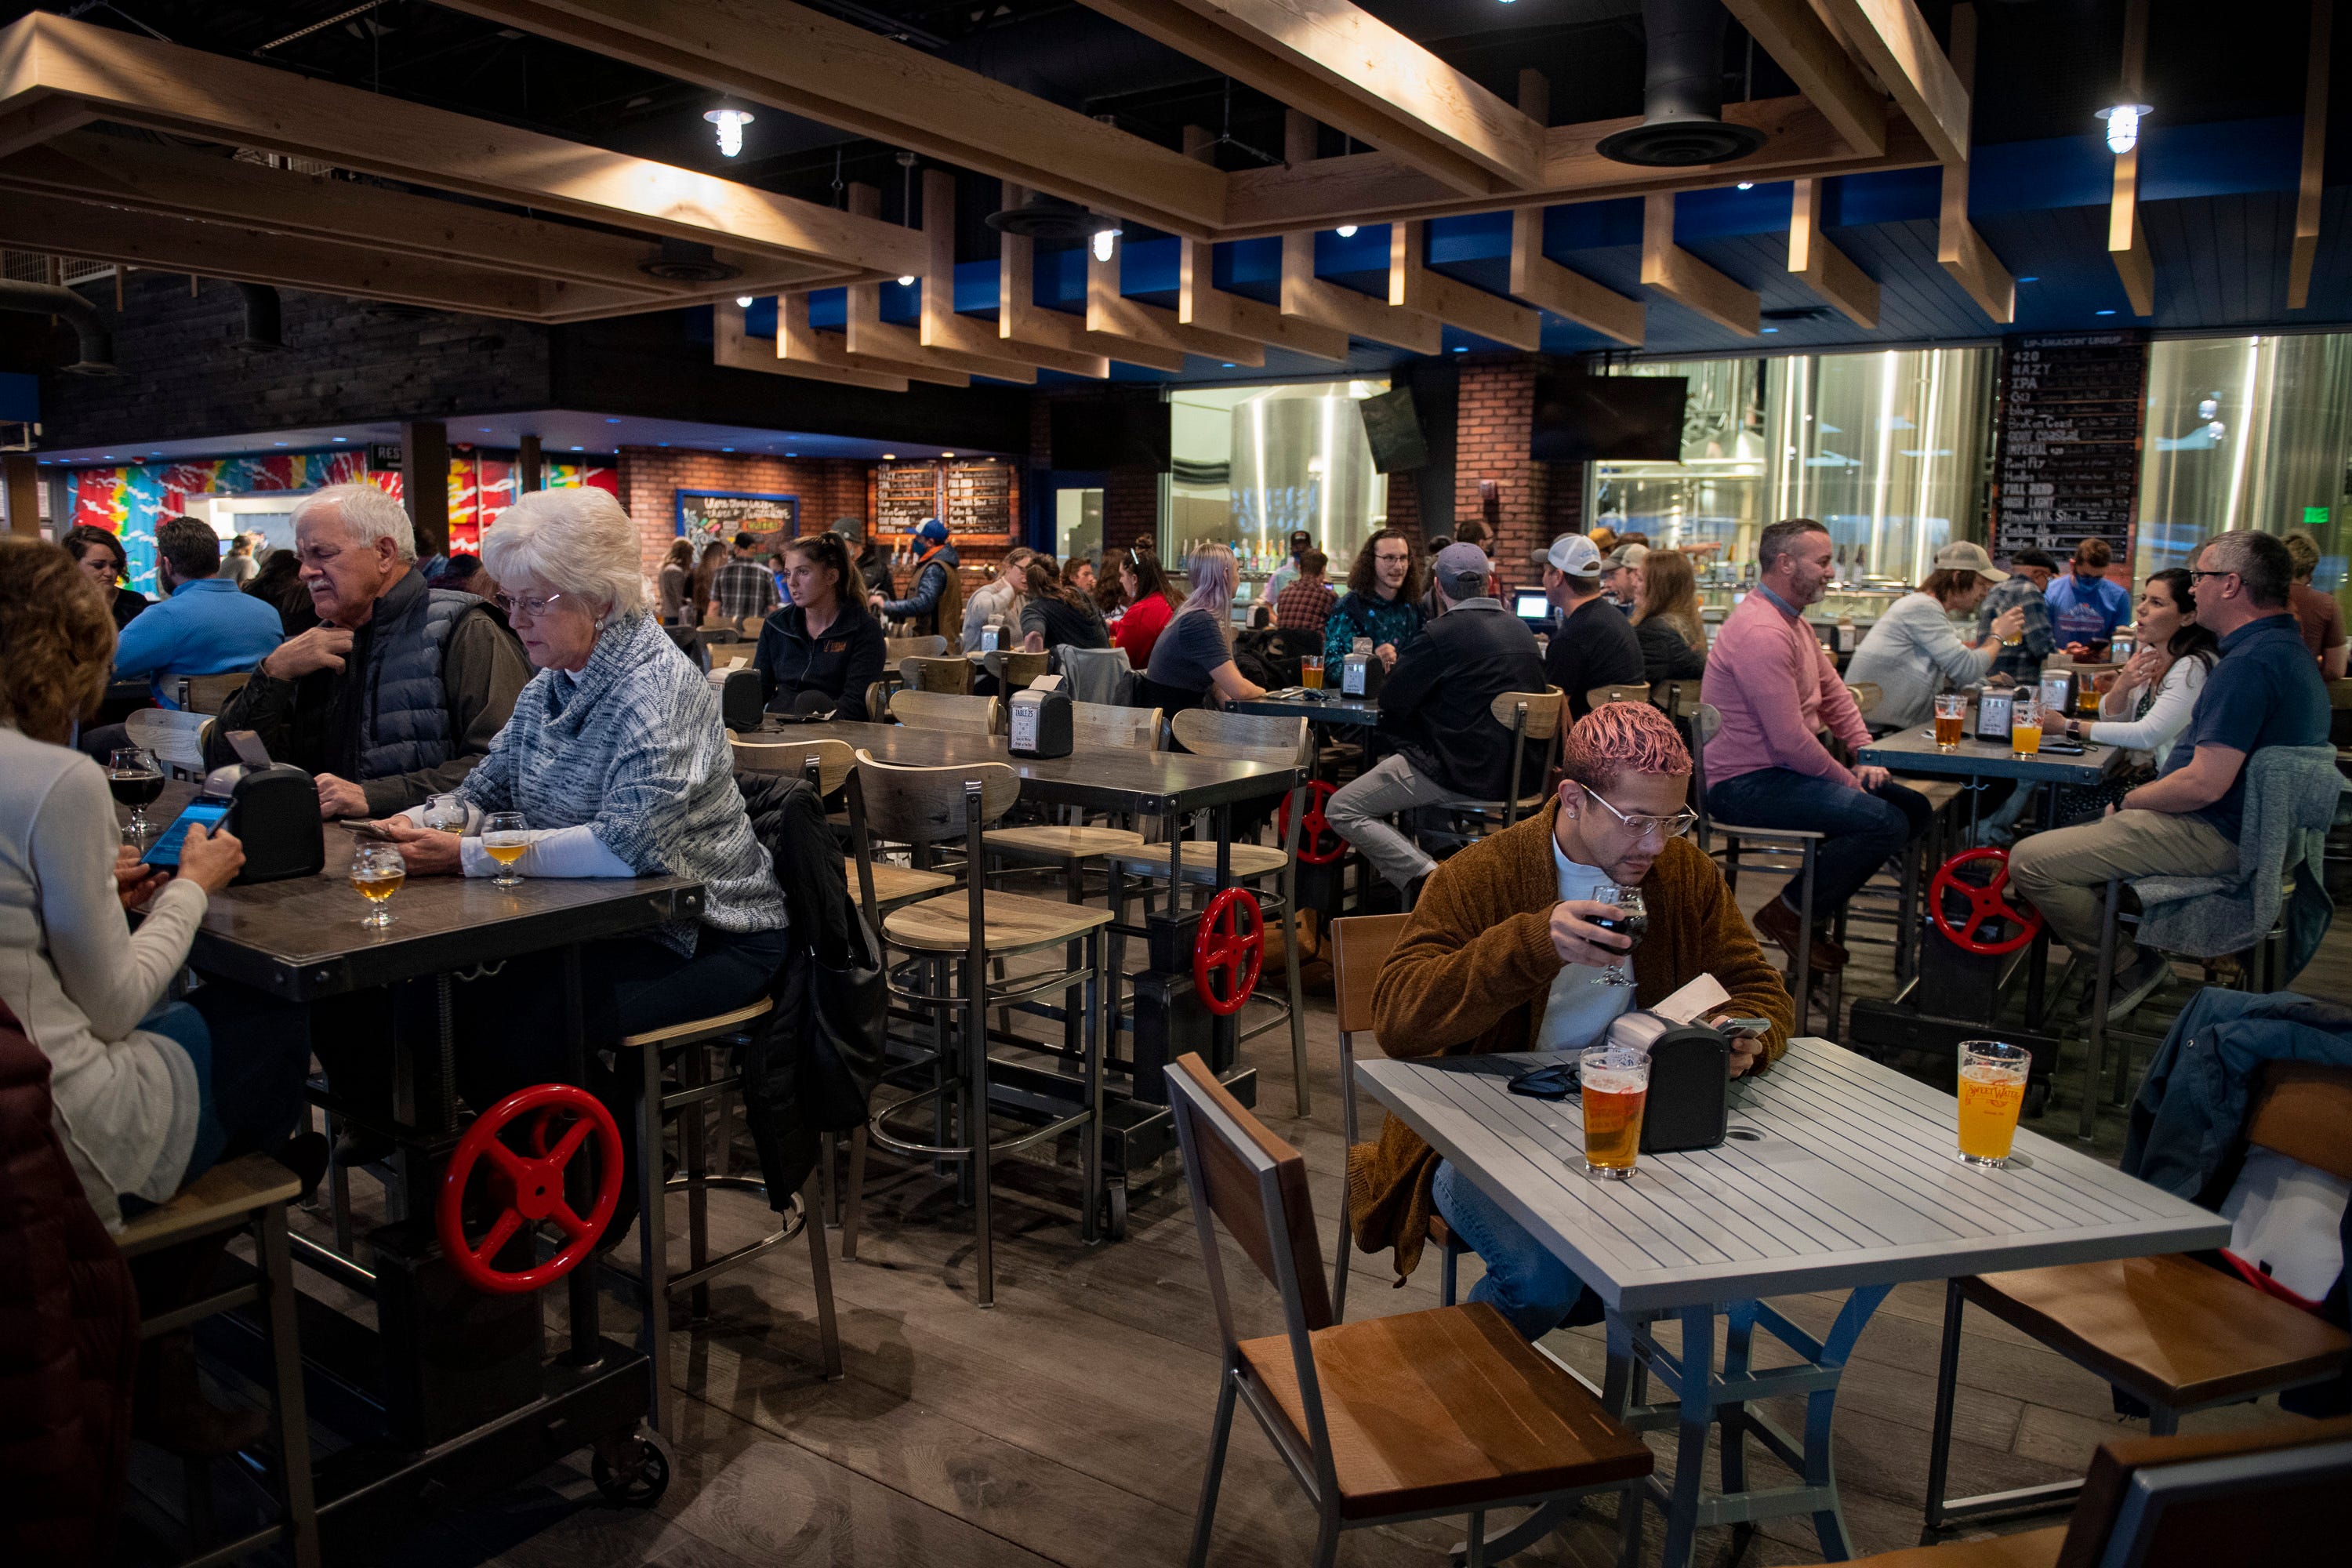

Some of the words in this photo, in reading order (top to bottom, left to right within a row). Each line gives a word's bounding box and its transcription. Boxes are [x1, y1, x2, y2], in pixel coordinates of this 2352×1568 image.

[2013, 351, 2040, 362] 420
[2011, 364, 2051, 376] HAZY
[2011, 376, 2038, 390] IPA
[378, 446, 401, 459] RES
[2055, 510, 2082, 522] Stout
[1015, 709, 1027, 717] TABLE
[1969, 1084, 2020, 1099] SWEETWATER
